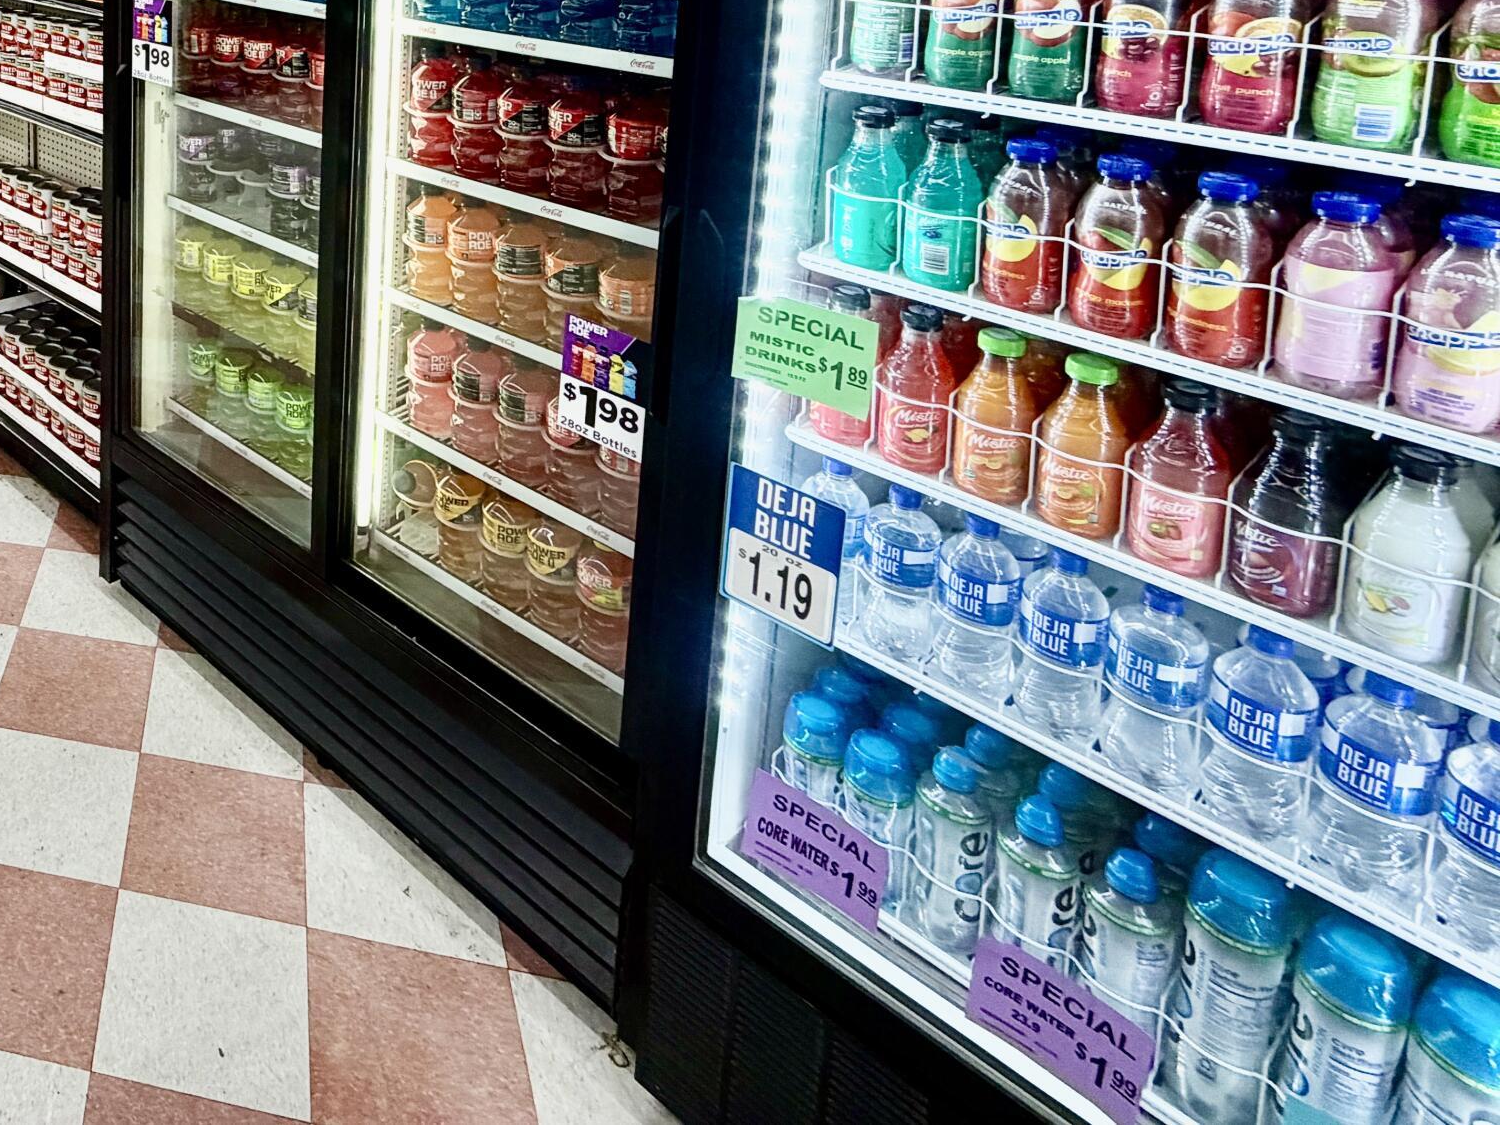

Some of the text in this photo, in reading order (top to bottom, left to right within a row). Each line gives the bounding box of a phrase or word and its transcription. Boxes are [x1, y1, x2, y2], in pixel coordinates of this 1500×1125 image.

[568, 324, 591, 340] ADE
[569, 315, 609, 338] POWER
[750, 331, 816, 356] MISTIC
[758, 306, 865, 352] SPECIAL
[745, 345, 817, 373] DRINKS
[818, 356, 868, 391] $189
[563, 382, 639, 434] $198
[560, 416, 638, 459] 28oz Bottles
[756, 477, 817, 528] DEJA
[754, 507, 813, 561] BLUE
[761, 544, 778, 557] 20
[873, 536, 901, 561] DEJA
[871, 554, 900, 577] BLUE
[949, 589, 983, 618] BLUE
[952, 573, 984, 600] DEJA
[1031, 627, 1069, 657] BLUE
[1033, 612, 1071, 640] DEJA
[1119, 646, 1154, 675] DEJA
[1117, 663, 1152, 694] BLUE
[1230, 695, 1276, 731] DEJA
[1228, 714, 1274, 751] BLUE
[1340, 742, 1392, 781] DEJA
[1337, 761, 1389, 802] BLUE
[757, 817, 789, 847] CORE
[790, 833, 830, 873] WATER
[772, 794, 877, 874] SPECIAL
[955, 832, 989, 924] core
[983, 975, 1022, 1005] CORE
[1026, 999, 1077, 1041] WATER
[1000, 956, 1137, 1062] SPECIAL
